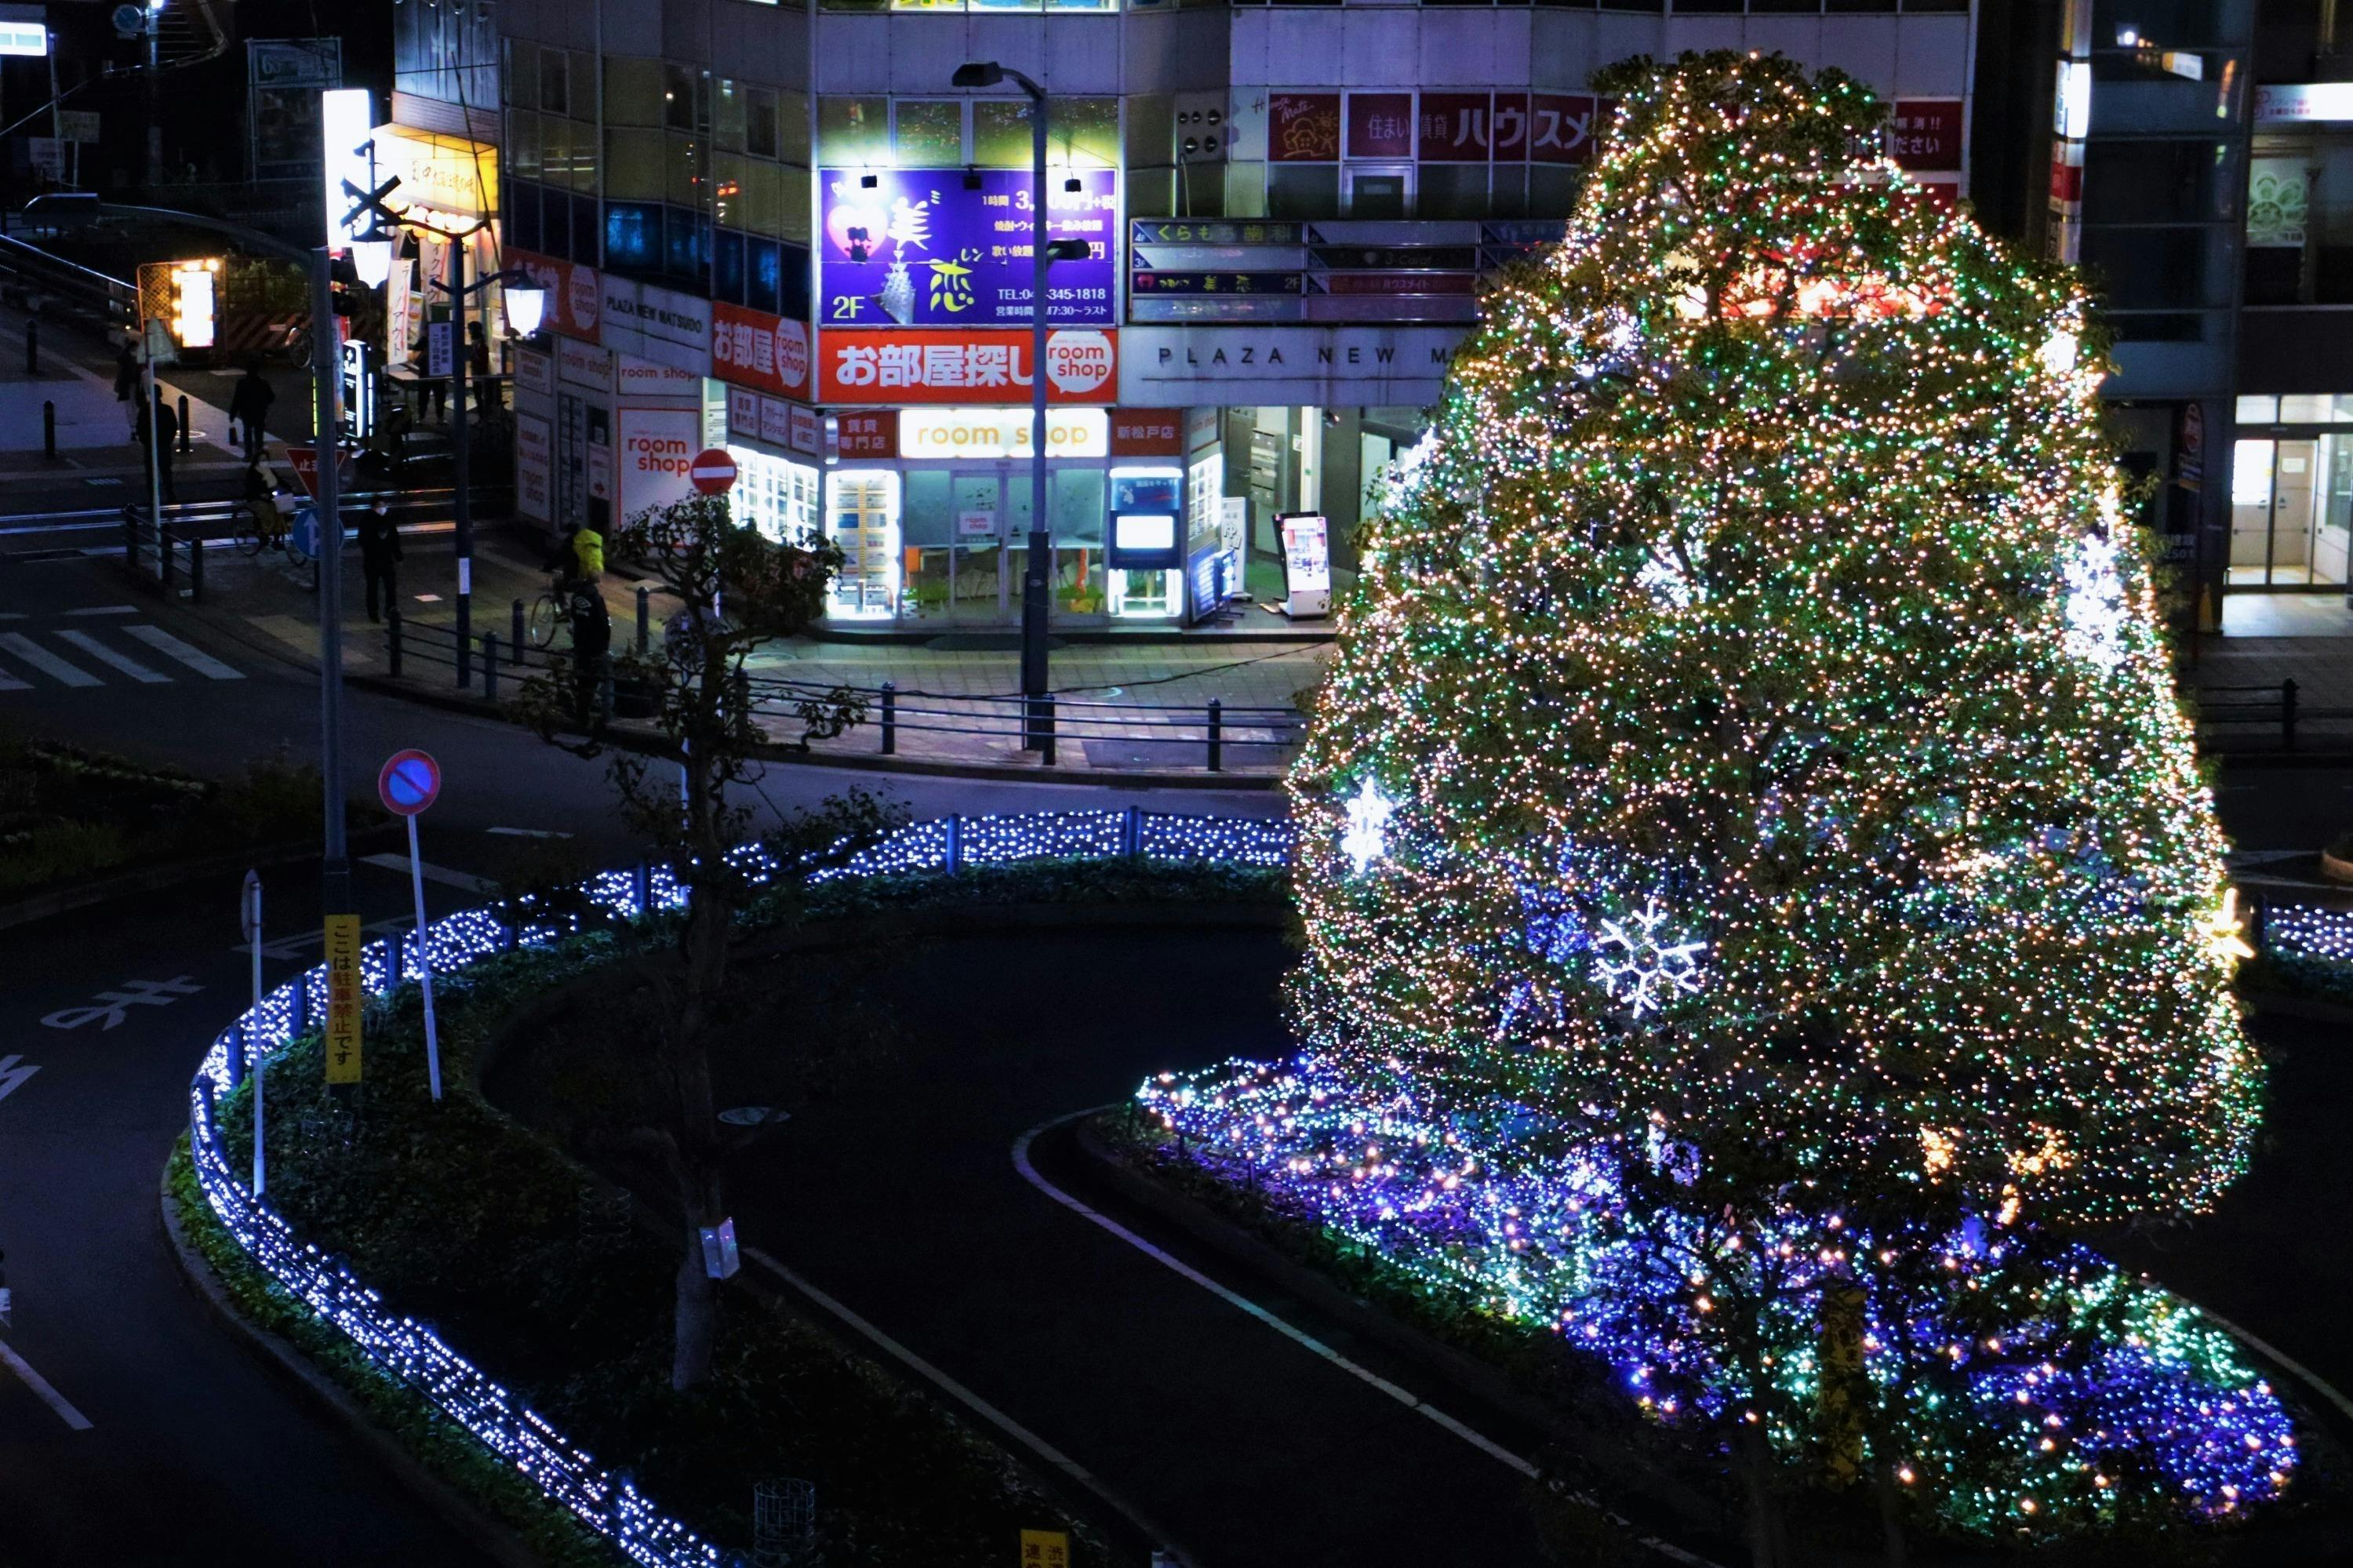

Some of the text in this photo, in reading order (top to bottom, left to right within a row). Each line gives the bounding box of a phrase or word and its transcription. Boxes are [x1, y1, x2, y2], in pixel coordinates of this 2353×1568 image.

[1453, 107, 1591, 148] ハウスメ
[929, 259, 974, 312] 恋
[606, 295, 704, 334] PLAZA NEW MATSUDO
[833, 296, 865, 318] 2F
[714, 319, 773, 376] お部屋
[776, 335, 804, 355] room
[1049, 347, 1104, 359] room
[1158, 347, 1283, 366] PLAZA
[1318, 347, 1395, 365] NEW
[621, 368, 657, 378] room
[781, 352, 806, 377] shop
[836, 344, 1034, 387] お部屋探し
[1057, 358, 1107, 381] shop
[840, 436, 886, 449] 専門店
[918, 425, 1089, 449] room sop
[1117, 425, 1175, 439] 新松戸店
[627, 438, 688, 454] room
[638, 450, 690, 478] shop
[333, 925, 352, 1067] ここは駐車禁止です
